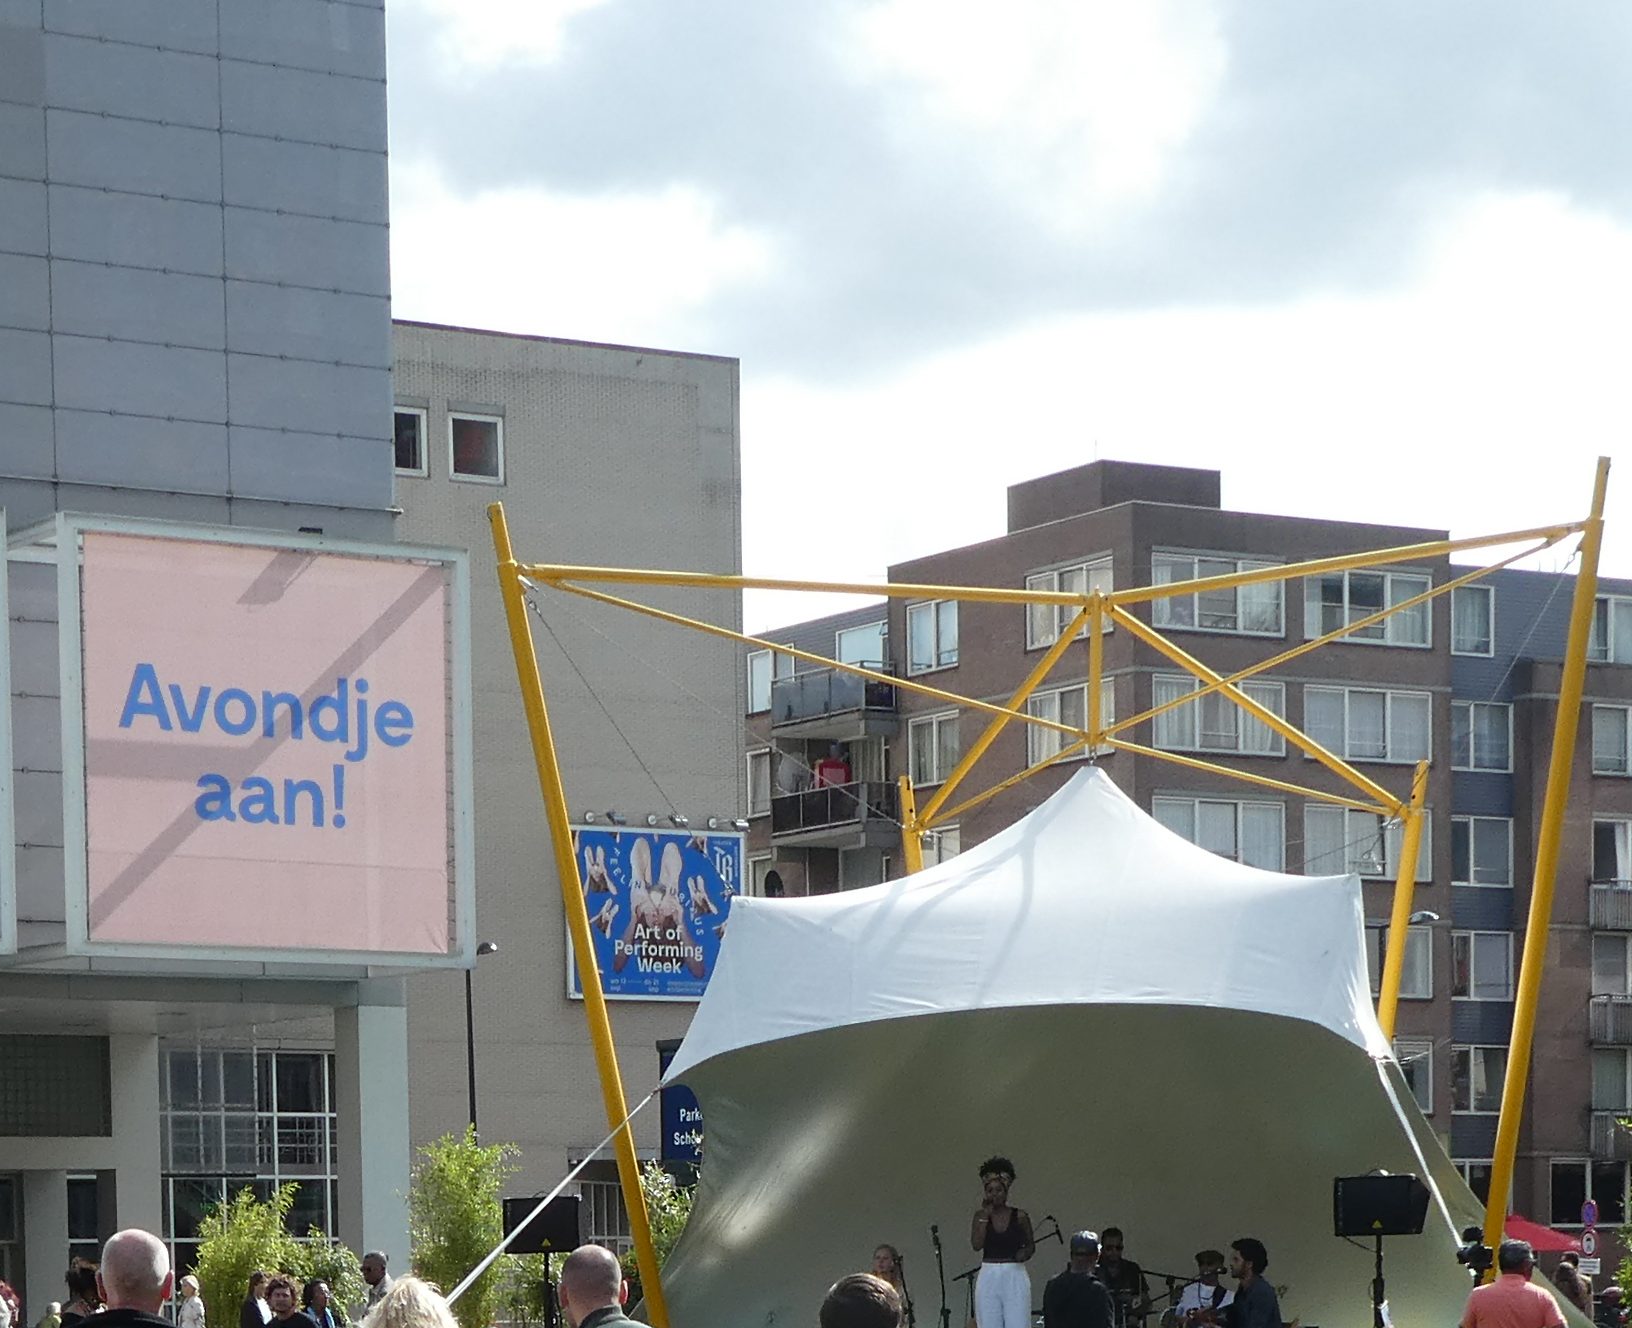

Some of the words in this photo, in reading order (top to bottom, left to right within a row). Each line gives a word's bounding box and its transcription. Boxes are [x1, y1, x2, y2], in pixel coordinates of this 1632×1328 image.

[118, 662, 415, 763] Avondje
[194, 764, 346, 829] aan!
[634, 923, 660, 940] Art
[666, 924, 683, 941] of
[614, 939, 704, 962] Performing
[637, 956, 682, 974] Week
